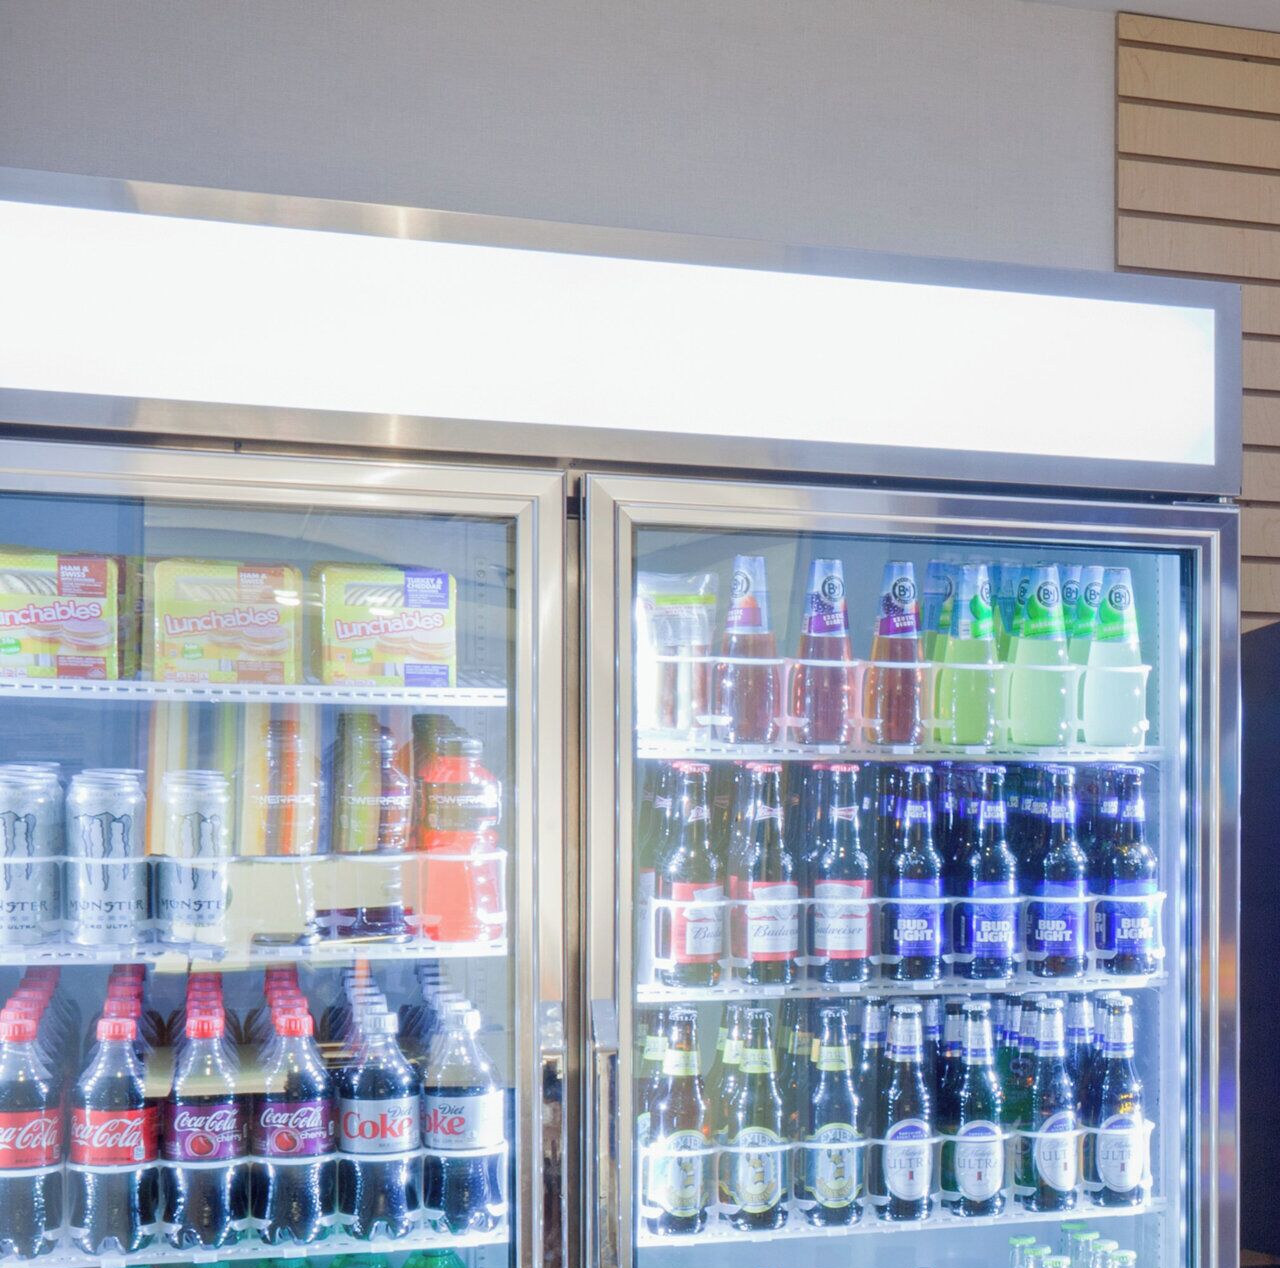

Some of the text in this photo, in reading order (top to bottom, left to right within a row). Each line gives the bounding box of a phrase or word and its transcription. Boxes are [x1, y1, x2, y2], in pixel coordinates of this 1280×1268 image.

[165, 608, 279, 635] Lunchables
[336, 611, 443, 639] Lunchables
[897, 919, 928, 931] BUD
[981, 921, 1011, 932] BUD
[1038, 920, 1067, 931] BUD
[1121, 918, 1150, 930] BUD
[894, 930, 934, 942] LIGHT
[976, 931, 1015, 943] LIGHT
[1035, 930, 1072, 942] LIGHT
[1116, 929, 1153, 940] LIGHT
[439, 1104, 466, 1115] Diet
[175, 1108, 240, 1132] Coca-Cola
[261, 1106, 325, 1129] Coca-Cola
[343, 1110, 413, 1139] Coke
[216, 1132, 242, 1143] cherry
[301, 1130, 327, 1140] cherry
